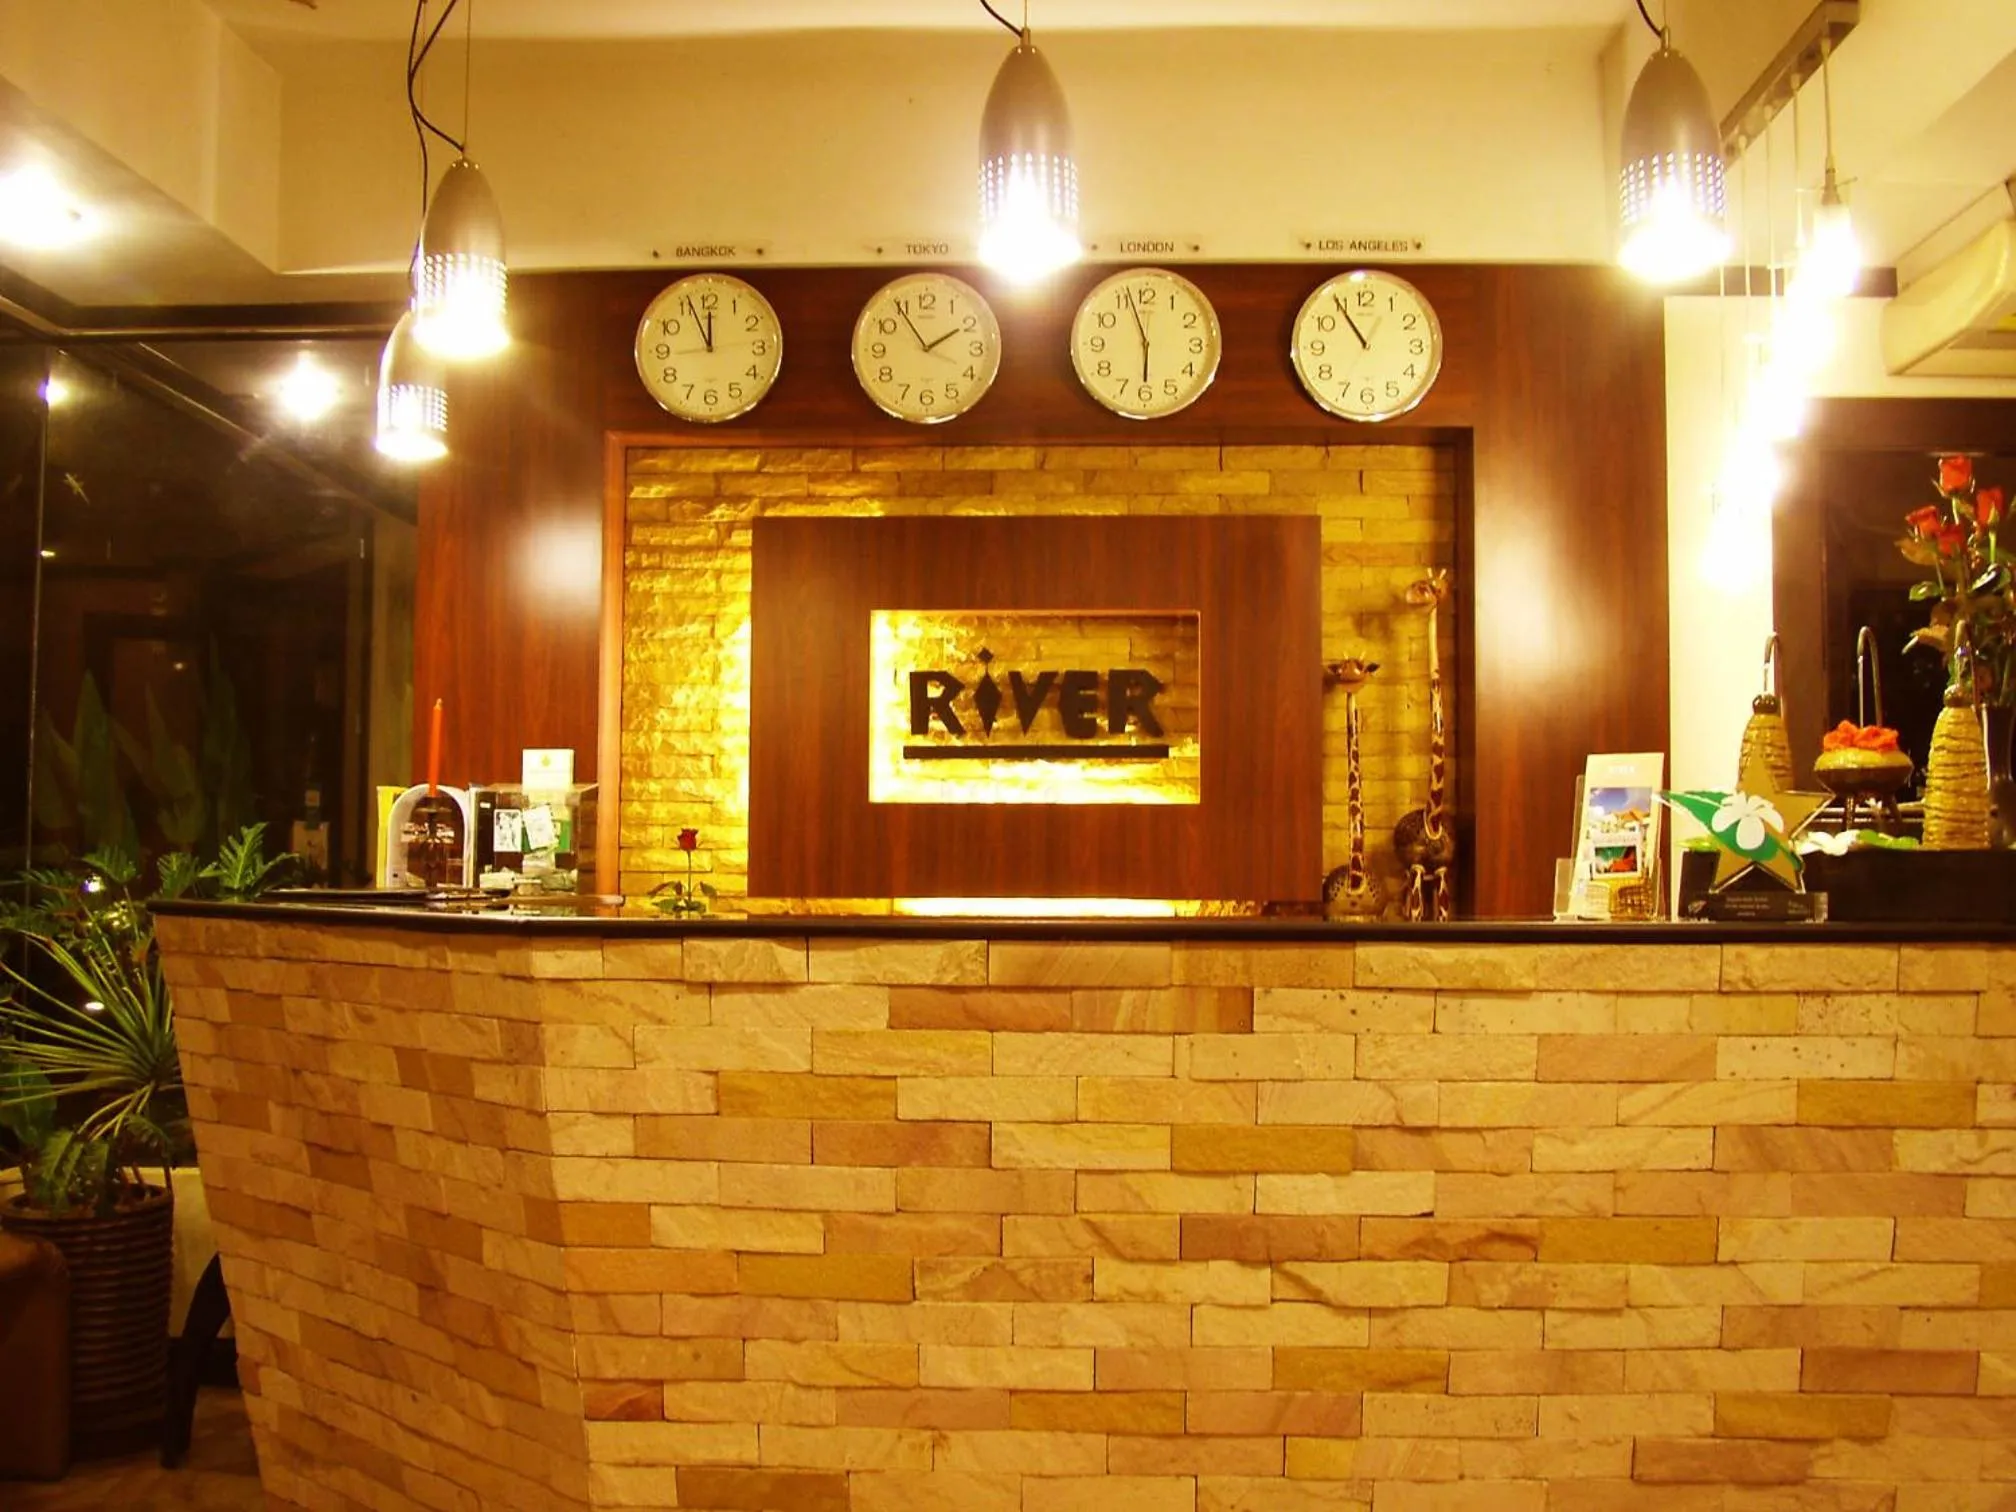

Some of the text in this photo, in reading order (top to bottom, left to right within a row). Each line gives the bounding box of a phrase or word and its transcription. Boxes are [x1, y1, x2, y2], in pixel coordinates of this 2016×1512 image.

[676, 246, 736, 257] BANGKOK
[906, 244, 948, 254] TOKYO
[1120, 241, 1174, 252] LONDON
[1319, 240, 1408, 251] LOS ANGELES
[702, 294, 718, 310] 12
[918, 293, 936, 310] 12
[1116, 293, 1129, 309] 11
[1138, 288, 1156, 304] 12
[1170, 295, 1174, 310] 1
[1357, 291, 1374, 307] 12
[1388, 296, 1393, 312] 1
[679, 301, 692, 316] 11
[732, 299, 736, 316] 1
[896, 300, 909, 314] 11
[949, 300, 954, 314] 1
[1335, 297, 1347, 312] 11
[662, 319, 680, 335] 10
[745, 315, 758, 331] 2
[879, 318, 897, 334] 10
[963, 316, 976, 332] 2
[1097, 312, 1116, 329] 10
[1183, 313, 1196, 329] 2
[1317, 316, 1335, 332] 10
[1403, 314, 1416, 330] 2
[656, 344, 670, 360] 9
[752, 339, 765, 356] 3
[872, 343, 886, 358] 9
[969, 341, 983, 356] 3
[1090, 336, 1105, 353] 9
[1189, 337, 1203, 353] 3
[1311, 340, 1325, 356] 9
[1409, 339, 1423, 355] 3
[663, 367, 677, 383] 8
[746, 365, 758, 380] 4
[879, 367, 892, 382] 8
[963, 366, 976, 380] 4
[1097, 360, 1111, 376] 8
[1182, 362, 1194, 377] 4
[1318, 364, 1332, 380] 8
[1403, 364, 1416, 378] 4
[683, 384, 694, 400] 7
[729, 383, 742, 398] 5
[898, 384, 910, 401] 7
[945, 384, 959, 399] 5
[1116, 379, 1129, 396] 7
[1138, 385, 1152, 401] 6
[1164, 379, 1177, 395] 5
[1338, 382, 1350, 398] 7
[1386, 381, 1399, 397] 5
[704, 389, 718, 405] 6
[920, 389, 934, 405] 6
[1360, 388, 1374, 404] 6
